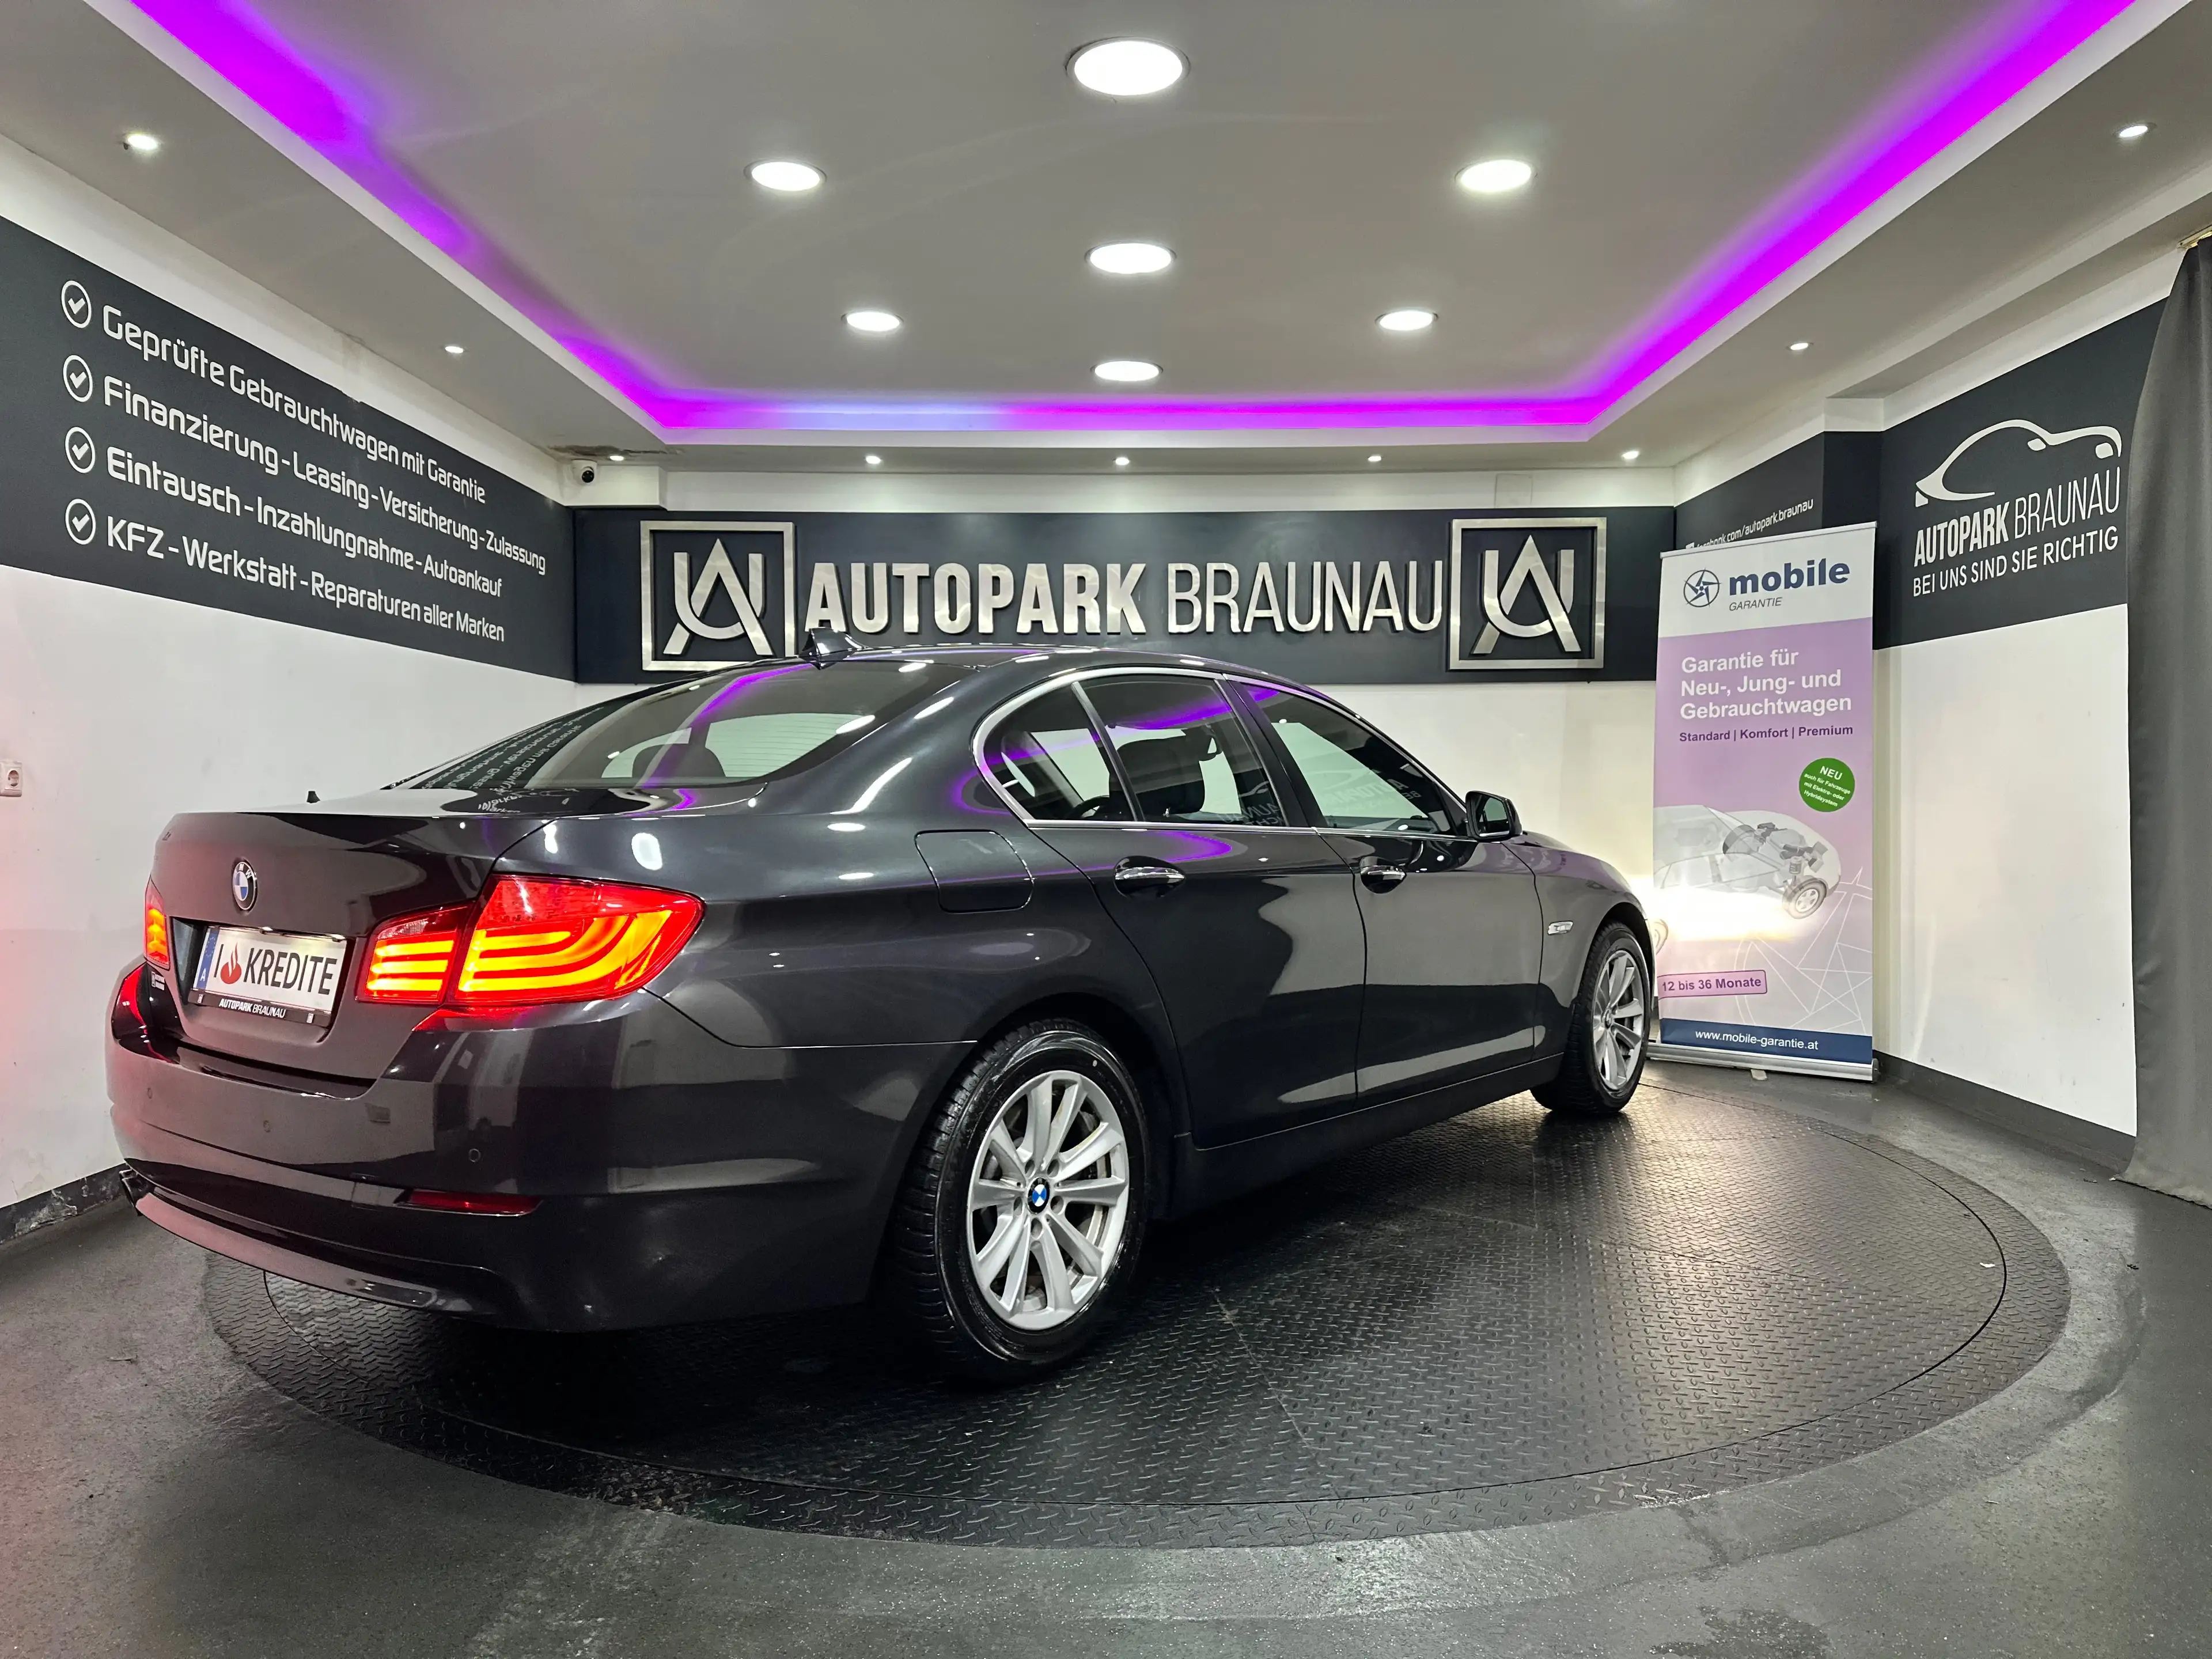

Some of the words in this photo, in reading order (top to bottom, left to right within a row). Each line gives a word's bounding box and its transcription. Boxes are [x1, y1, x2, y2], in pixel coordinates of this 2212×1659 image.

[104, 305, 224, 387] Geprüfte
[230, 365, 398, 465] Gebrauchtwagen
[402, 452, 425, 475] mit
[428, 459, 485, 503] Garantie
[1914, 501, 2010, 567] AUTOPARK
[2015, 467, 2120, 539] BRAUNAU
[1914, 573, 1936, 597] BEI
[1940, 566, 1967, 590] UNS
[1971, 555, 2007, 583] SIND
[2012, 546, 2037, 573] SIE
[2044, 526, 2118, 565] RICHTIG
[1730, 558, 1850, 596] mobile
[805, 562, 1146, 634] AUTOPARK
[1167, 560, 1443, 634] BRAUNAU
[1729, 597, 1782, 611] GARANTIE
[424, 604, 453, 628] aller
[456, 611, 504, 641] Marken
[1681, 652, 1763, 673] Garantie
[1770, 649, 1799, 666] für
[1681, 681, 1730, 696] Neu-,
[1737, 676, 1795, 694] Jung-
[1802, 669, 1841, 688] und
[1680, 698, 1851, 720] Gebrauchtwagen
[1680, 730, 1730, 742] Standard
[1740, 728, 1788, 740] Komfort
[1799, 726, 1853, 736] Premium
[1820, 766, 1843, 780] NEU
[1804, 790, 1838, 806] Hybridsystem
[1825, 781, 1850, 794] Fahrzeuge
[199, 971, 206, 982] A
[214, 944, 224, 978] I
[244, 948, 337, 995] KREDITE
[1662, 982, 1675, 991] 12
[1679, 980, 1695, 990] bis
[1698, 979, 1711, 989] 36
[1716, 978, 1762, 988] Monate
[219, 998, 252, 1012] AUTOPARK
[252, 1001, 286, 1018] BRAUNAU
[1695, 1031, 1819, 1050] www.mobile-garantie.at
